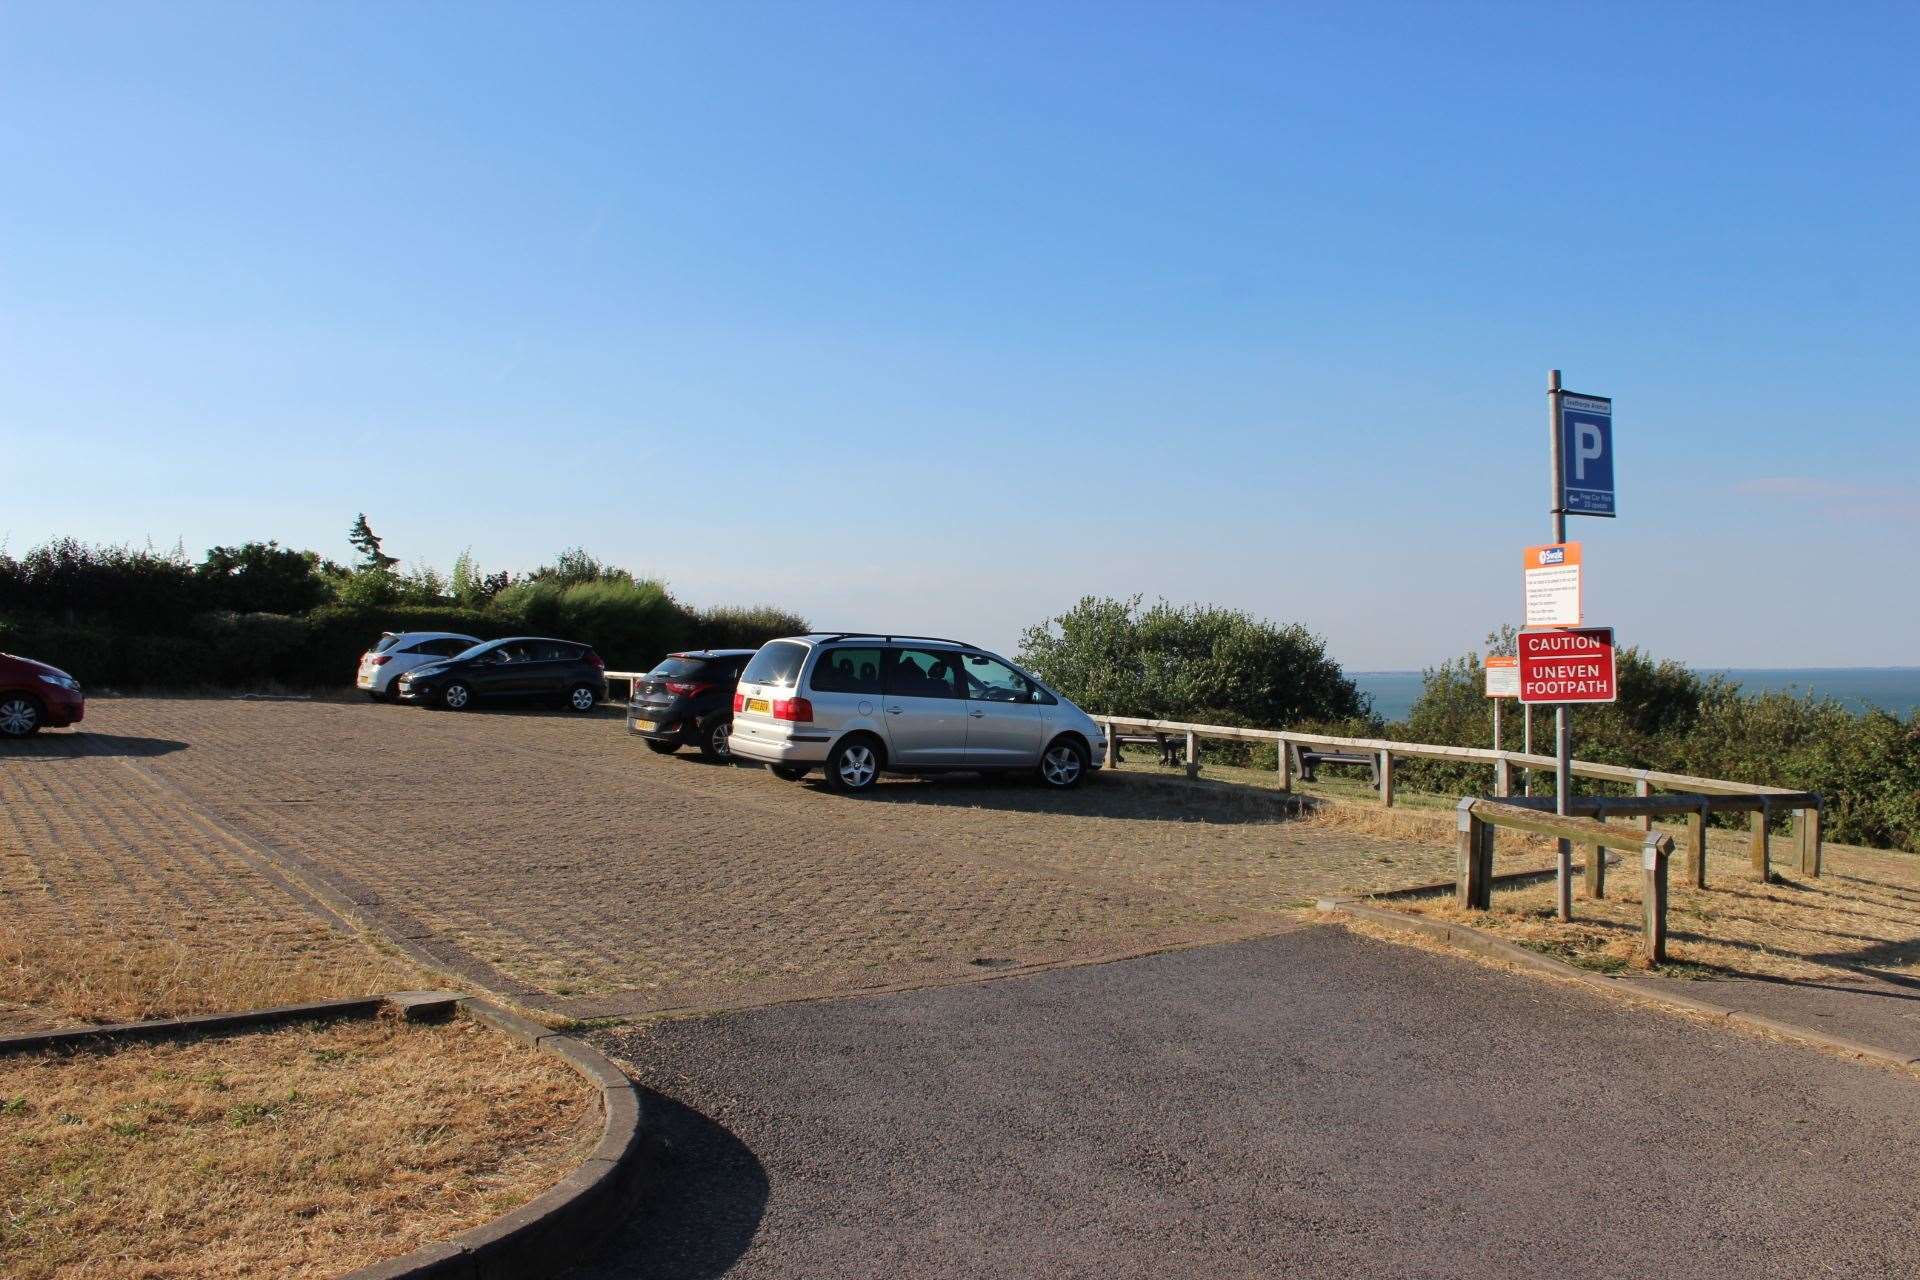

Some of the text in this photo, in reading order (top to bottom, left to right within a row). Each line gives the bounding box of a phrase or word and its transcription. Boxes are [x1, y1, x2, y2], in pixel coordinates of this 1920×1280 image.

[1574, 422, 1602, 480] P
[1528, 636, 1600, 651] CAUTION
[1533, 665, 1599, 678] UNEVEN
[1526, 680, 1607, 694] FOOTPATH
